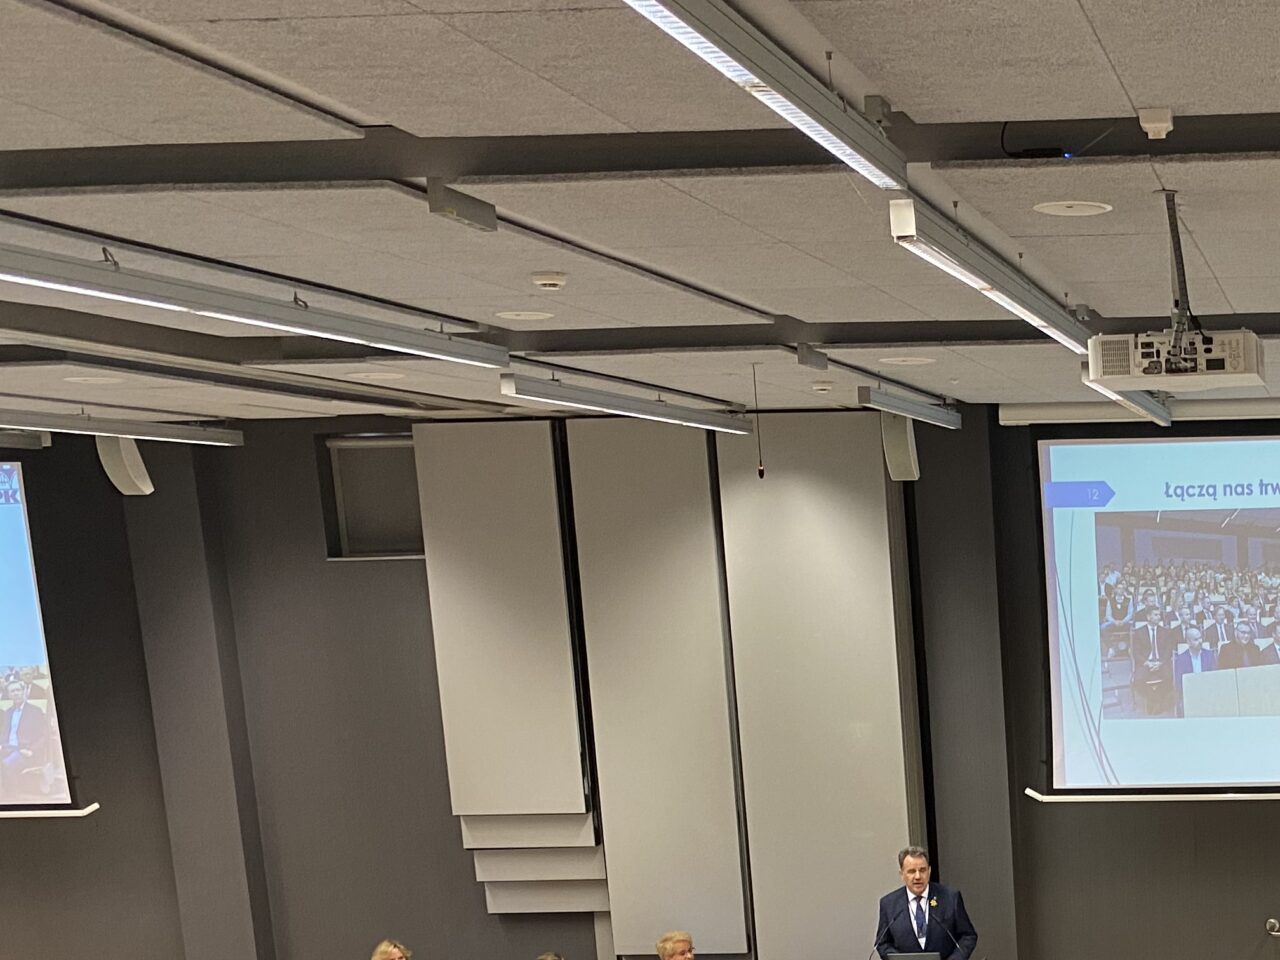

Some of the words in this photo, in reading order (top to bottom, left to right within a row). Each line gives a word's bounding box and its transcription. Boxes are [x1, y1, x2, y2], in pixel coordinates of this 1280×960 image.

[1087, 488, 1099, 500] 12
[1164, 481, 1217, 501] Łączą
[1223, 482, 1254, 496] nas
